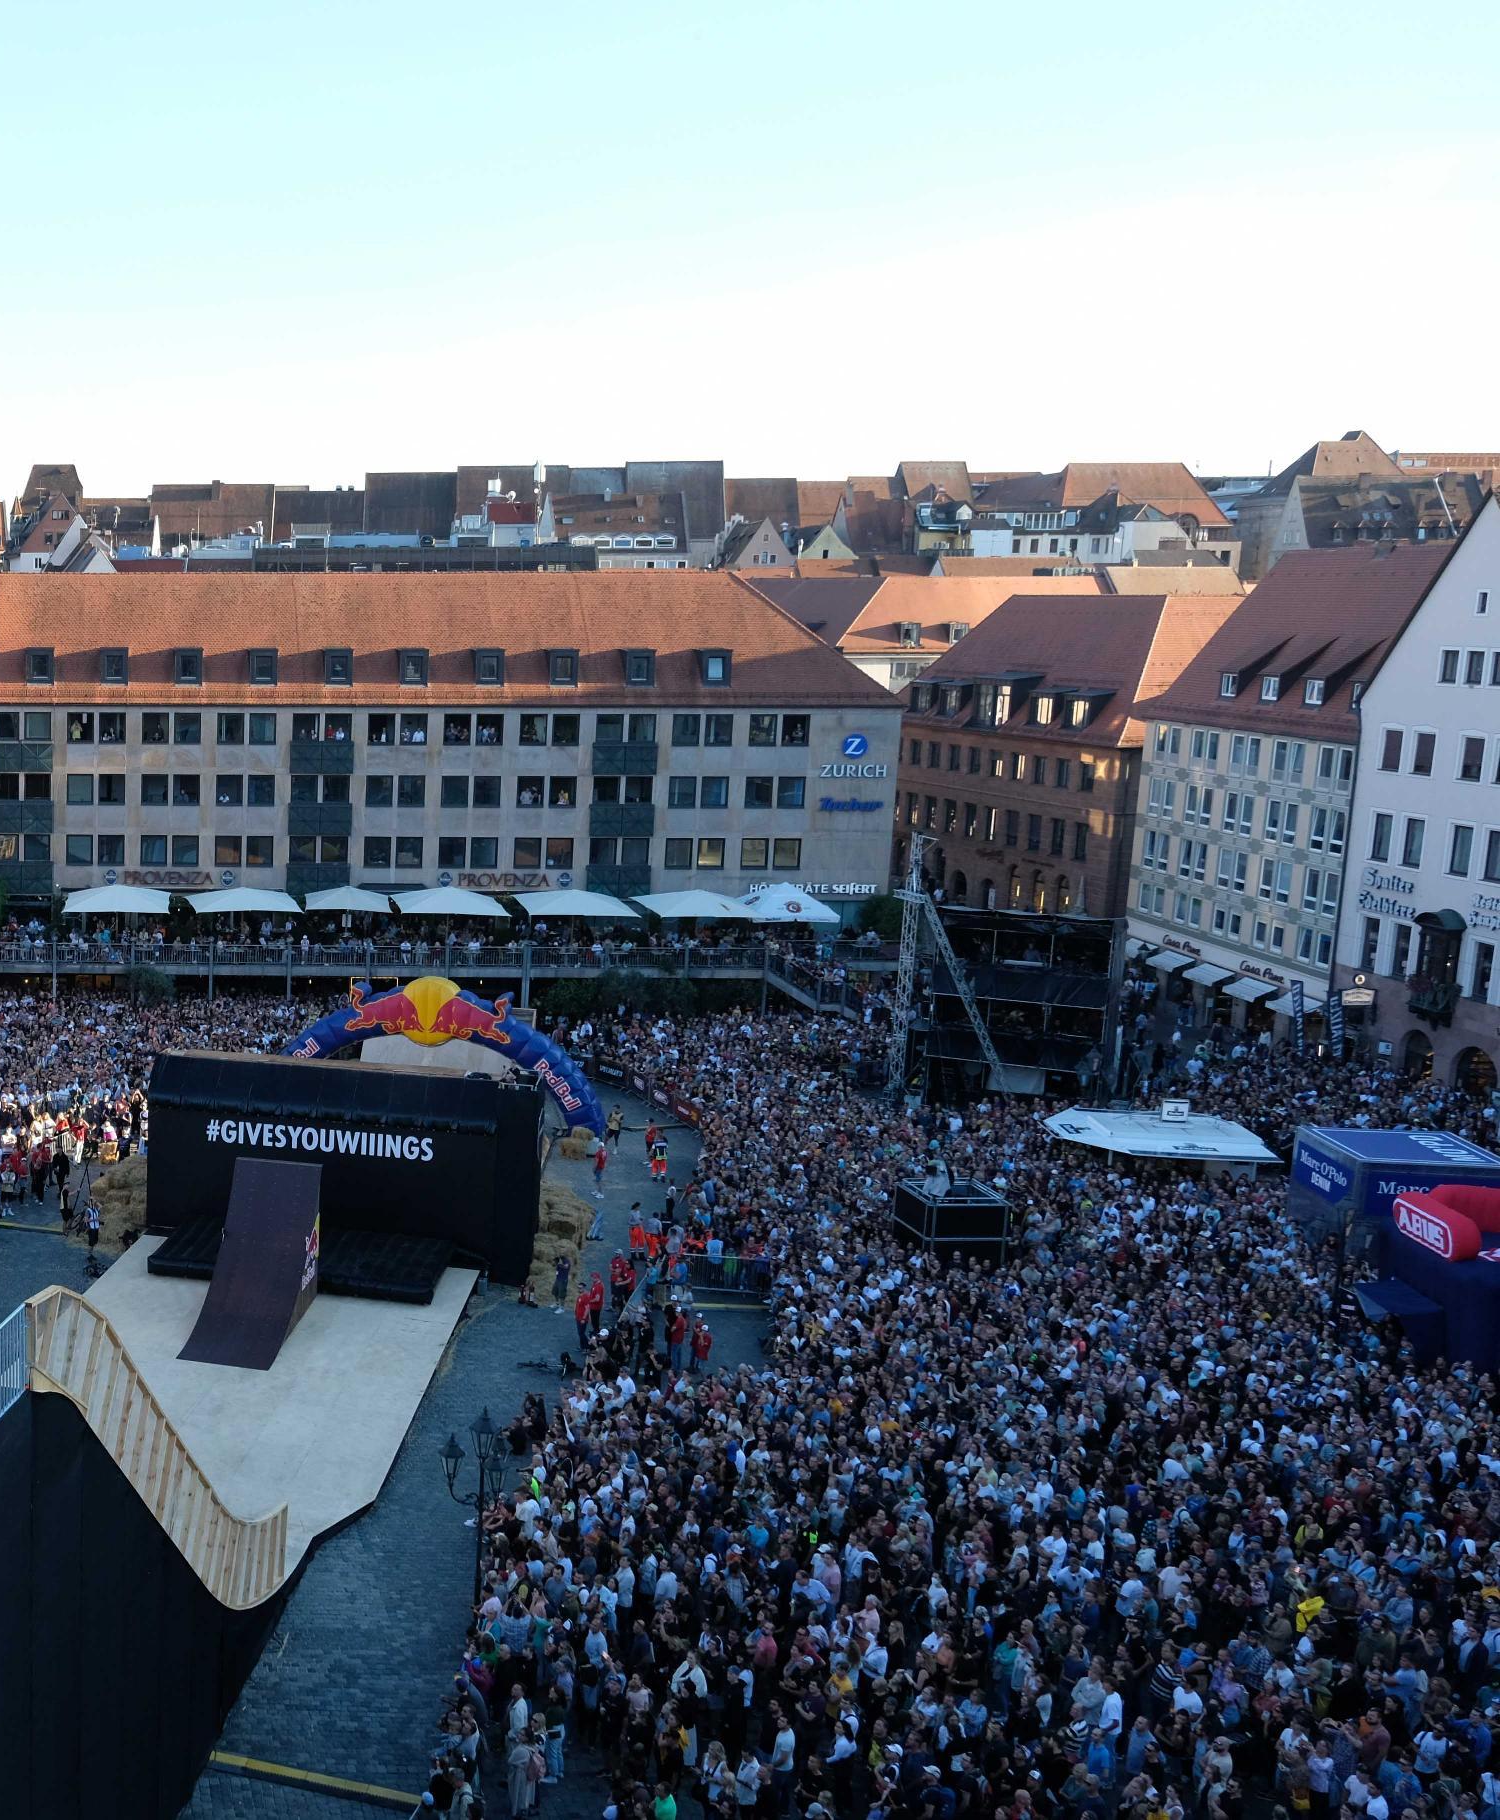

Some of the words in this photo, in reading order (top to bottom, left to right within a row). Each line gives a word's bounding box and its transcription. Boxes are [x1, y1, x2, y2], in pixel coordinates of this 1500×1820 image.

[820, 764, 887, 778] ZURICH
[123, 870, 214, 885] PROVENZA
[457, 873, 549, 887] PROVENZA
[206, 1119, 434, 1162] #GIVESYOUWIIINGS
[1300, 1149, 1320, 1171] Marc
[1320, 1162, 1347, 1187] O'Polo
[1311, 1171, 1331, 1192] DENIM
[1399, 1206, 1444, 1250] ABUS
